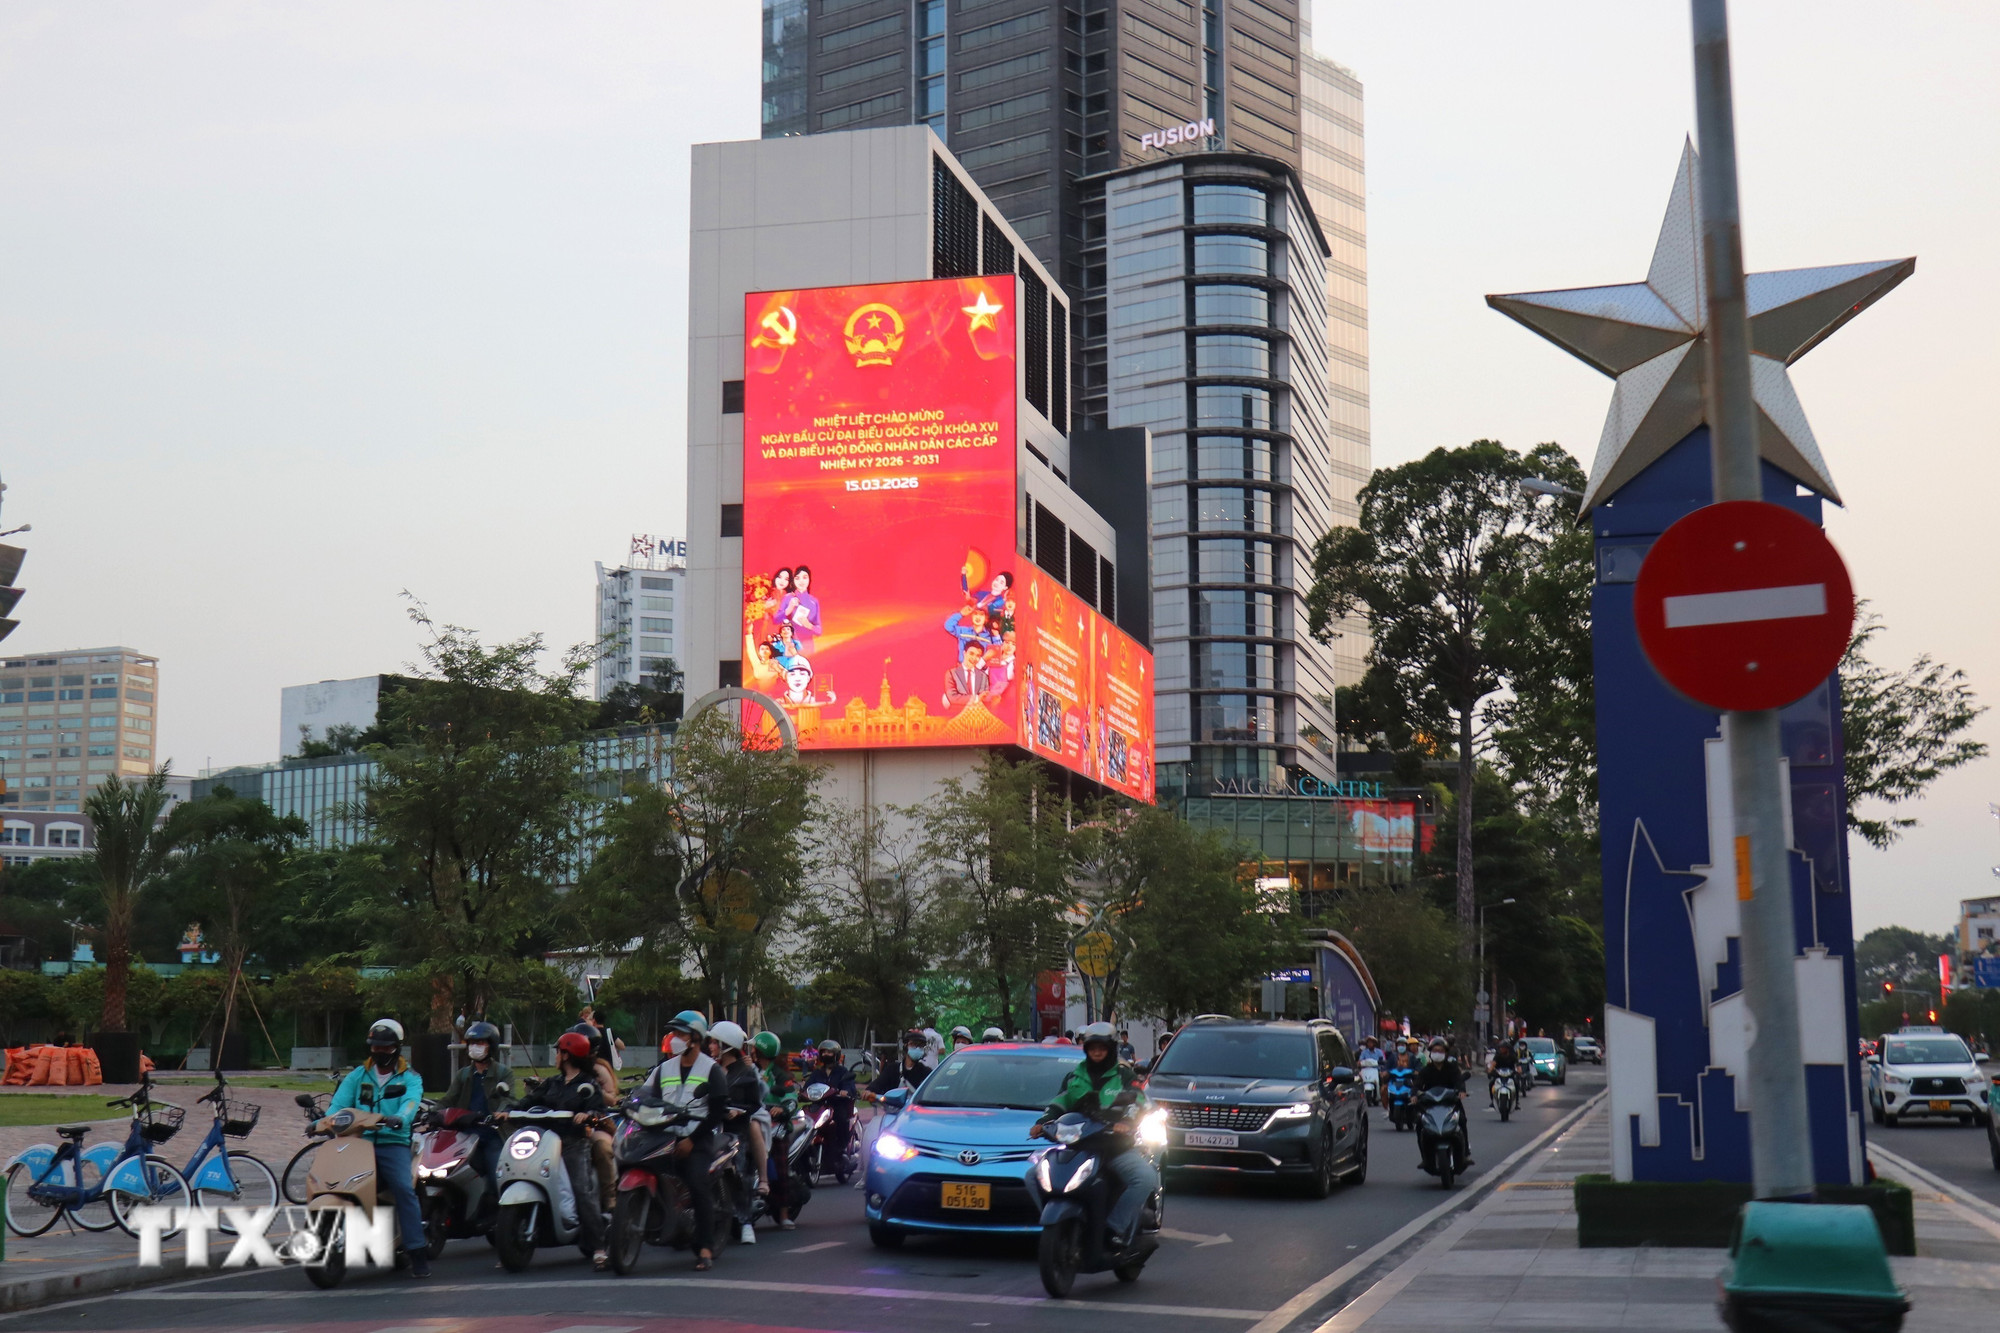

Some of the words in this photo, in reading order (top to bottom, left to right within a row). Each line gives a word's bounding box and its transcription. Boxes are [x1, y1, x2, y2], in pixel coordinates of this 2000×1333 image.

[1141, 118, 1215, 152] FUSION
[813, 413, 847, 429] NHIỆT
[849, 412, 873, 427] LIỆT
[873, 410, 907, 424] CHÀO
[909, 408, 944, 422] MỪNG
[761, 431, 791, 445] NGÀY
[836, 430, 856, 442] ĐẠI
[885, 422, 920, 438] QUỐC
[922, 422, 943, 437] HỘI
[944, 420, 977, 434] KHÓA
[979, 421, 999, 432] XVI
[762, 445, 777, 459] VÀ
[778, 447, 797, 459] ĐẠI
[827, 442, 847, 457] HỘI
[849, 439, 883, 454] ĐỒNG
[884, 438, 918, 452] NHÂN
[920, 437, 944, 450] DÂN
[946, 435, 971, 449] CÁC
[973, 432, 998, 447] CẤP
[820, 456, 856, 471] NHIỆM
[858, 455, 873, 468] KỲ
[875, 455, 904, 467] 2026
[913, 454, 940, 465] 2031
[844, 477, 919, 492] 15.03.2026
[1214, 776, 1298, 796] SAIGON
[955, 1184, 977, 1196] 51G
[946, 1195, 985, 1208] 051.90
